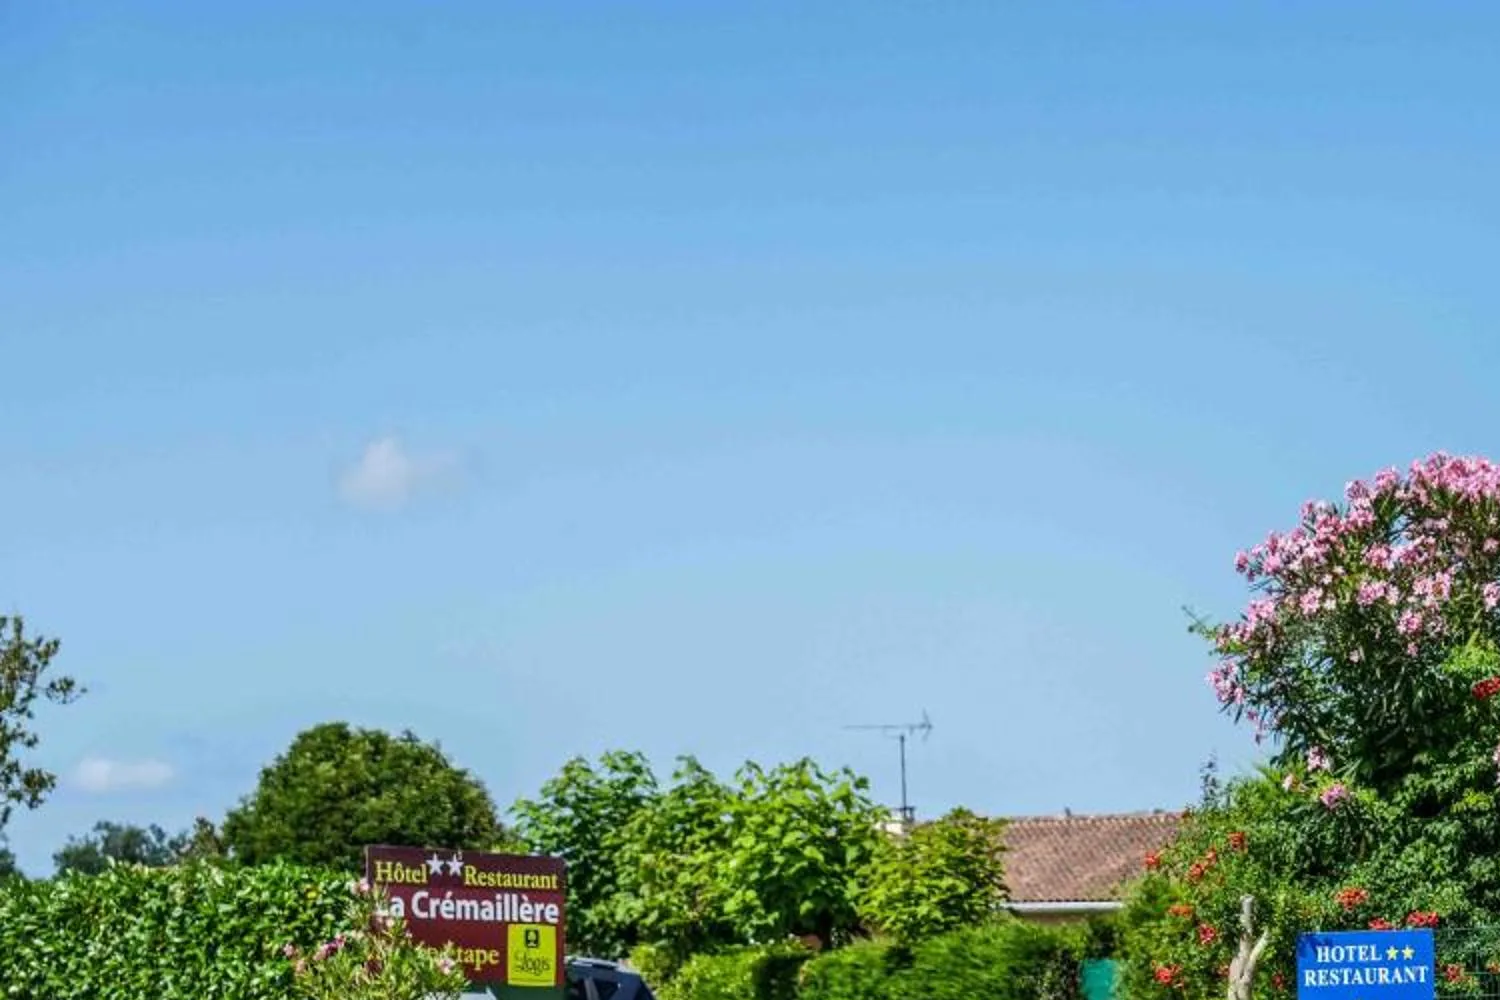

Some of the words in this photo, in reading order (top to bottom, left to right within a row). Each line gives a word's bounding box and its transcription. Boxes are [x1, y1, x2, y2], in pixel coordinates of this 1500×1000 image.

[375, 860, 428, 884] Hôtel
[464, 864, 558, 890] Restaurant
[411, 891, 560, 923] Crémaillère
[1316, 944, 1383, 962] HOTEL
[1304, 966, 1429, 987] RESTAURANT
